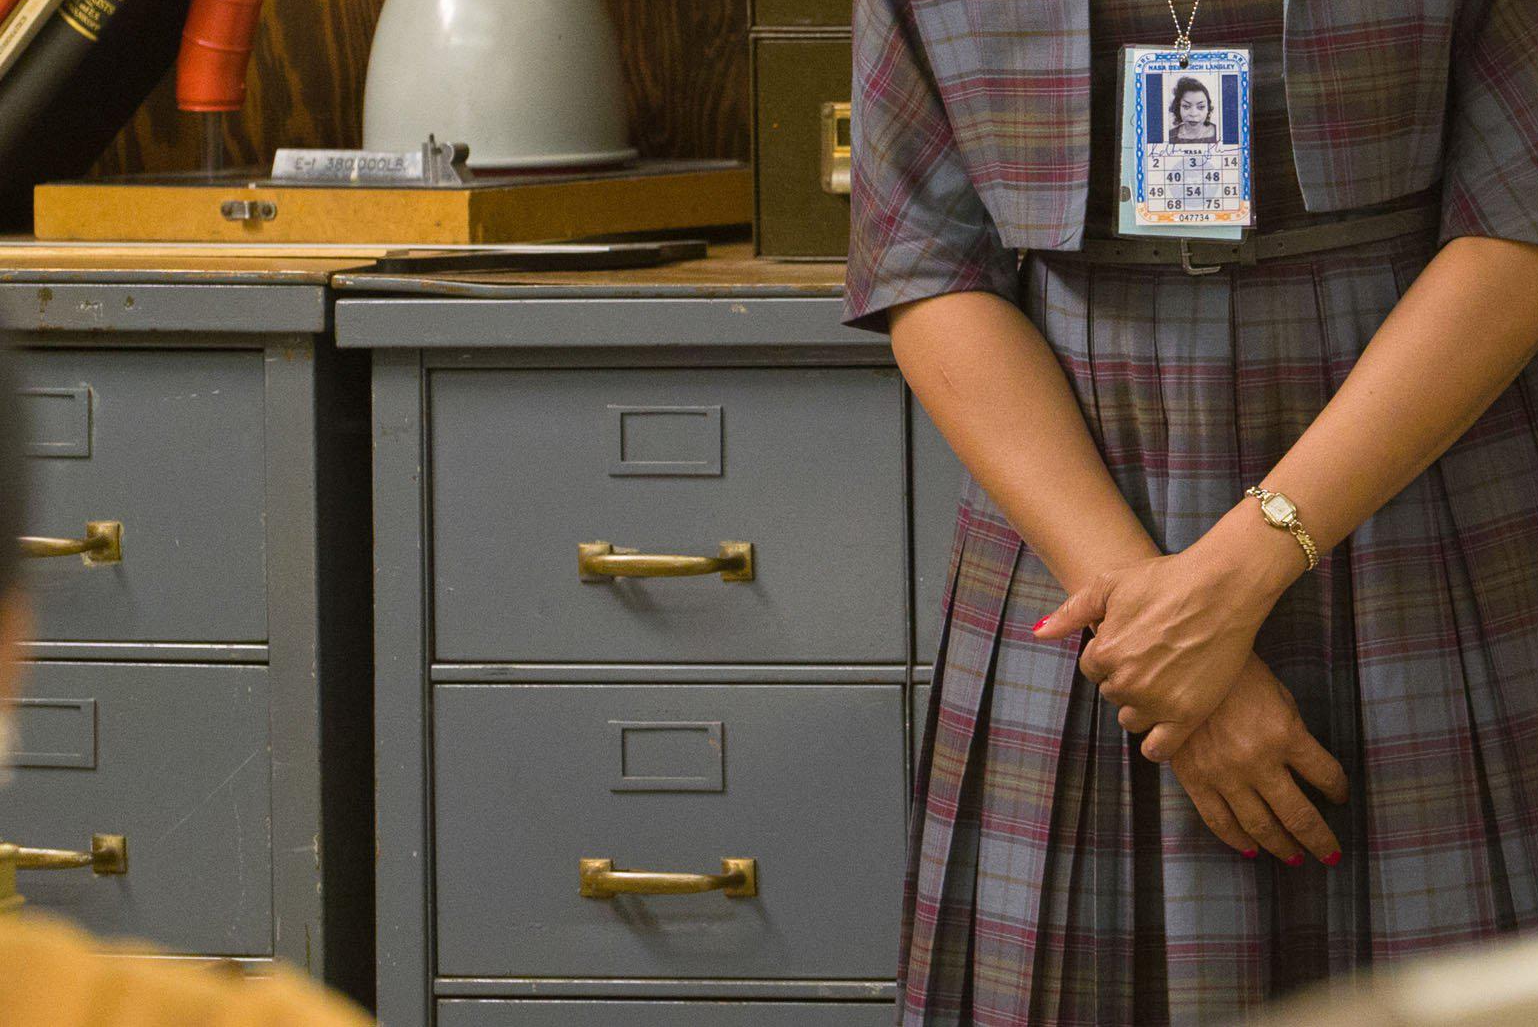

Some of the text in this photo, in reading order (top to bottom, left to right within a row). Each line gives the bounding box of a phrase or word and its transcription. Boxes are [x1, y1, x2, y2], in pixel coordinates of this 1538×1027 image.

[1205, 63, 1236, 71] LANGLEY
[1153, 157, 1238, 168] 2 3 14
[1167, 172, 1220, 182] 40 48
[1149, 186, 1238, 197] 49 54 61
[1167, 199, 1220, 210] 68 75
[1178, 214, 1209, 222] 047734
